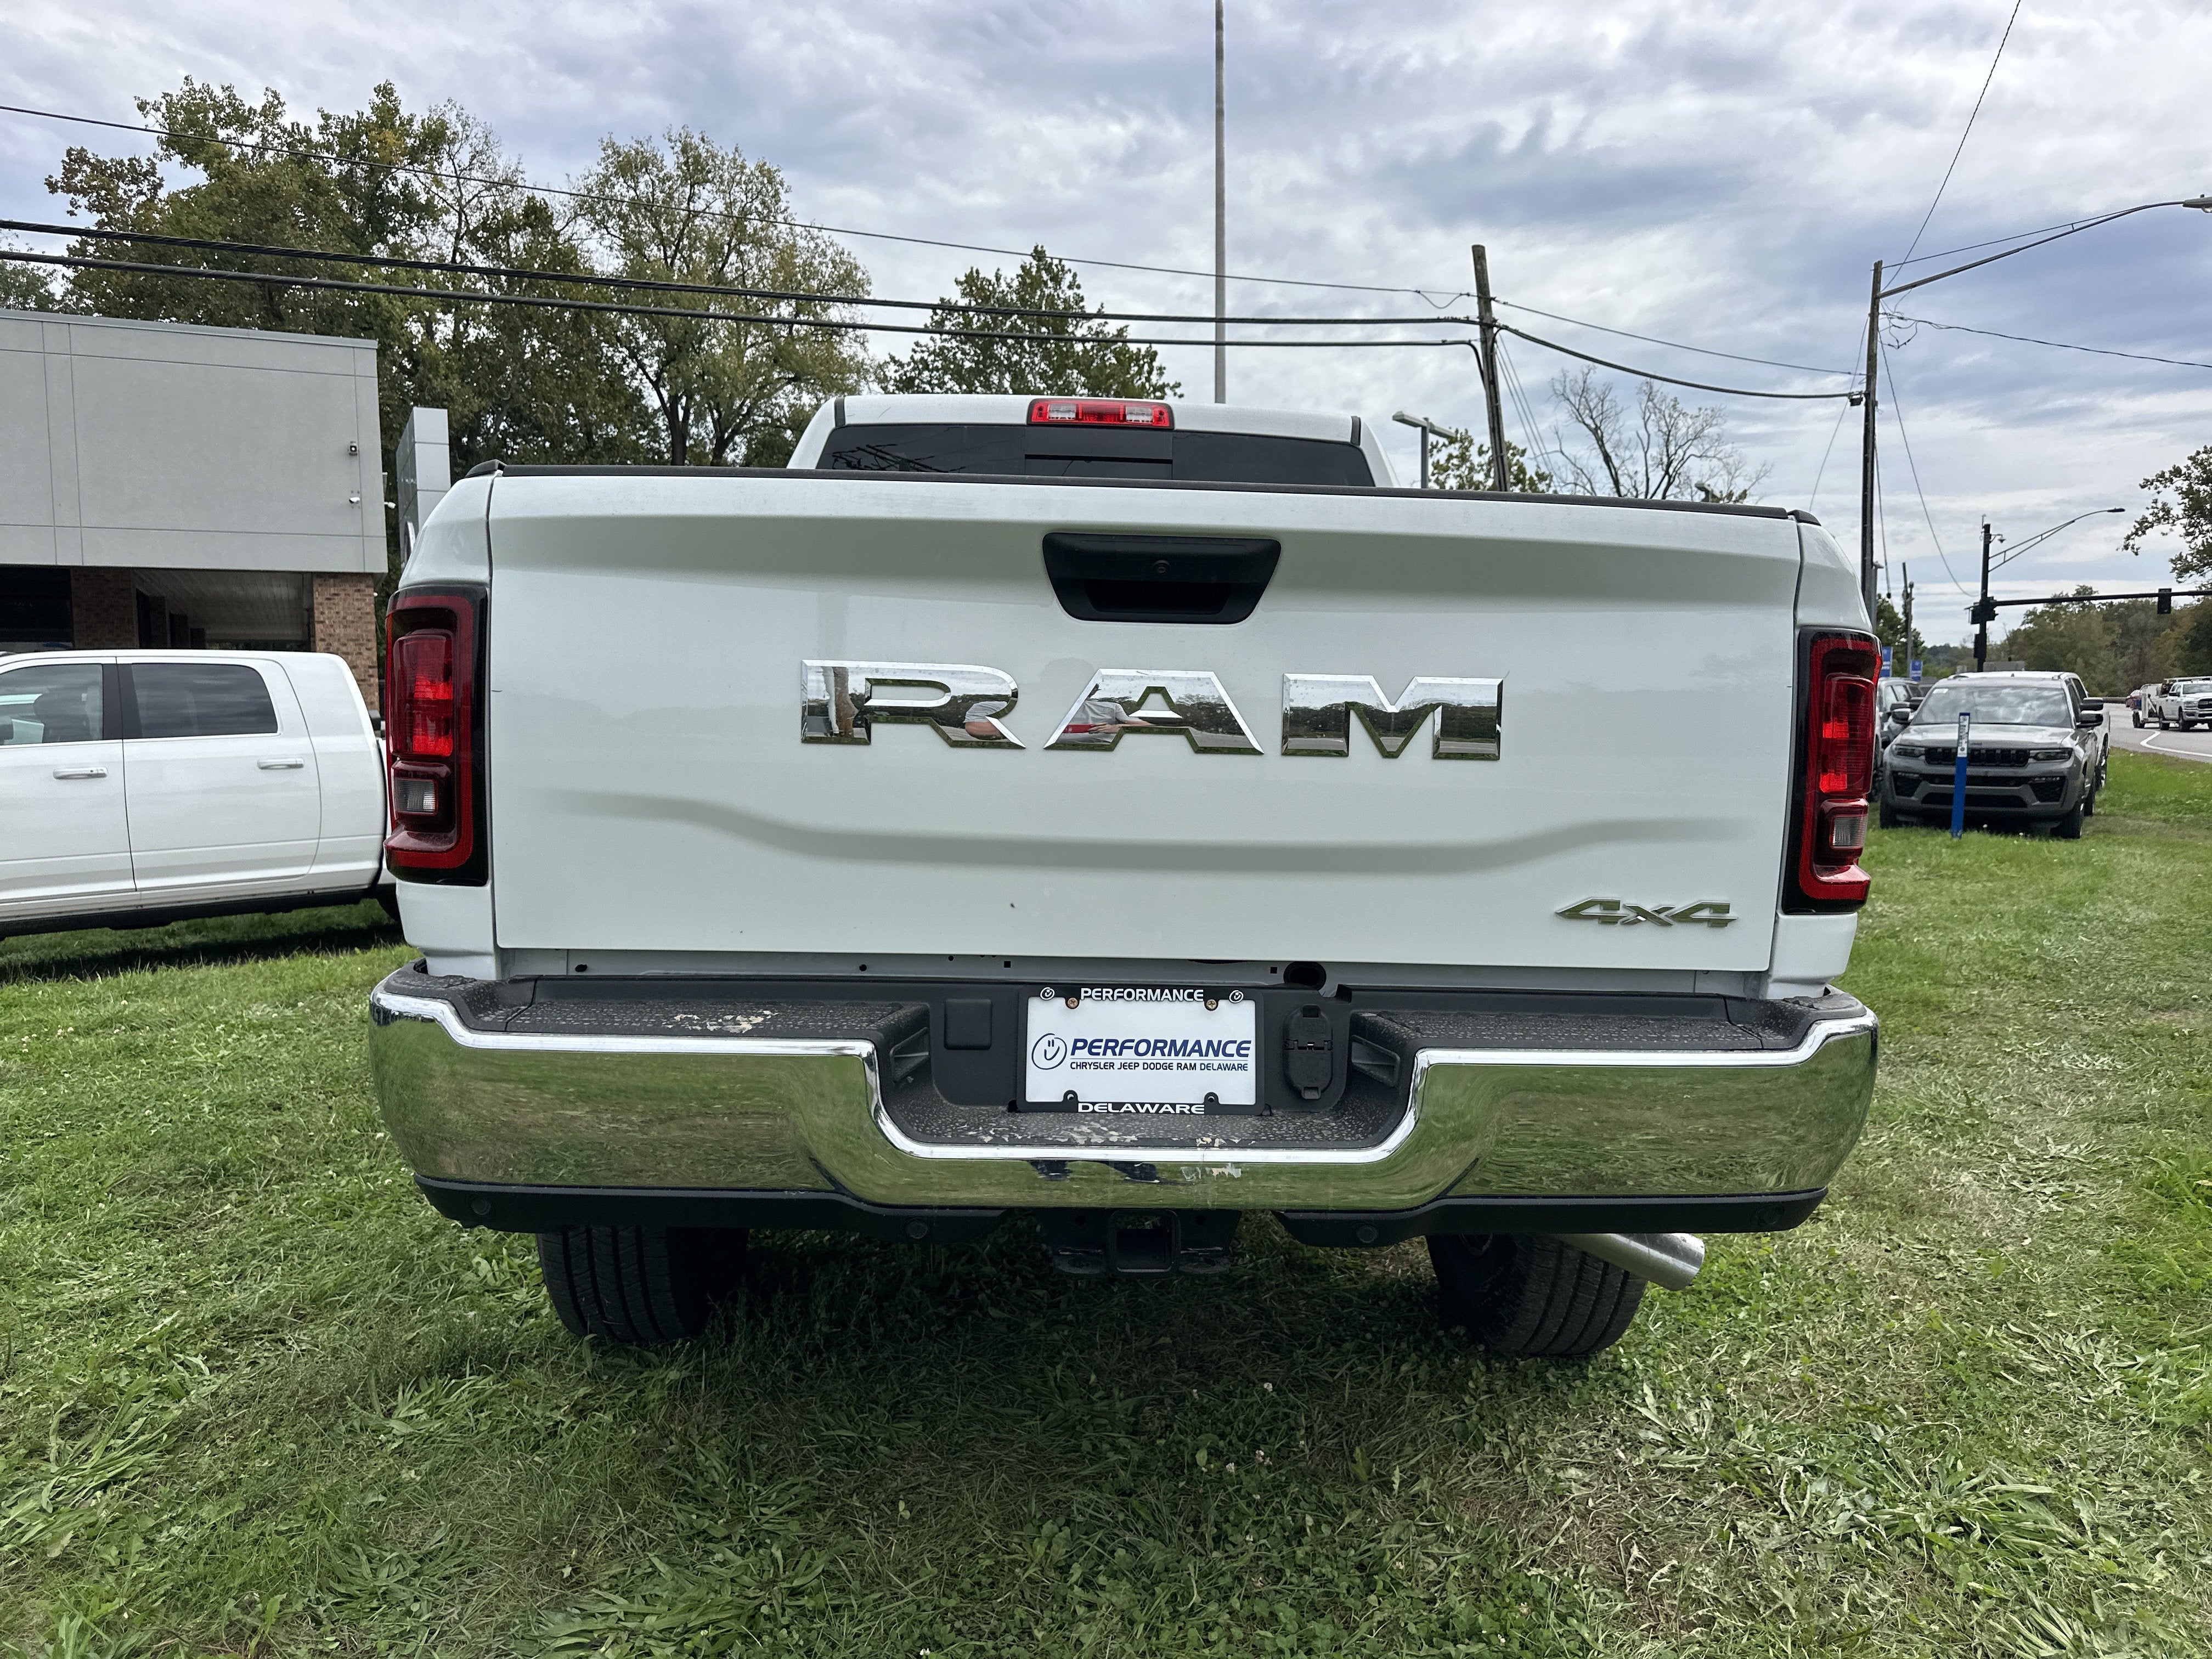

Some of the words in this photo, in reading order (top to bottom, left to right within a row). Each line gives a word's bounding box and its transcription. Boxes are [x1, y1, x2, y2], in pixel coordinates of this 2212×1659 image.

[801, 659, 1504, 761] RAM
[1081, 988, 1204, 1002] PERFORMANCE
[1070, 1039, 1251, 1058] PERFORMANCE
[1070, 1062, 1115, 1070] CHRYSLER
[1117, 1062, 1139, 1070] JEEP
[1143, 1062, 1173, 1070] DODGE
[1176, 1063, 1197, 1071] RAM
[1199, 1063, 1248, 1071] DELAWARE
[1077, 1103, 1205, 1114] DELAWARE
